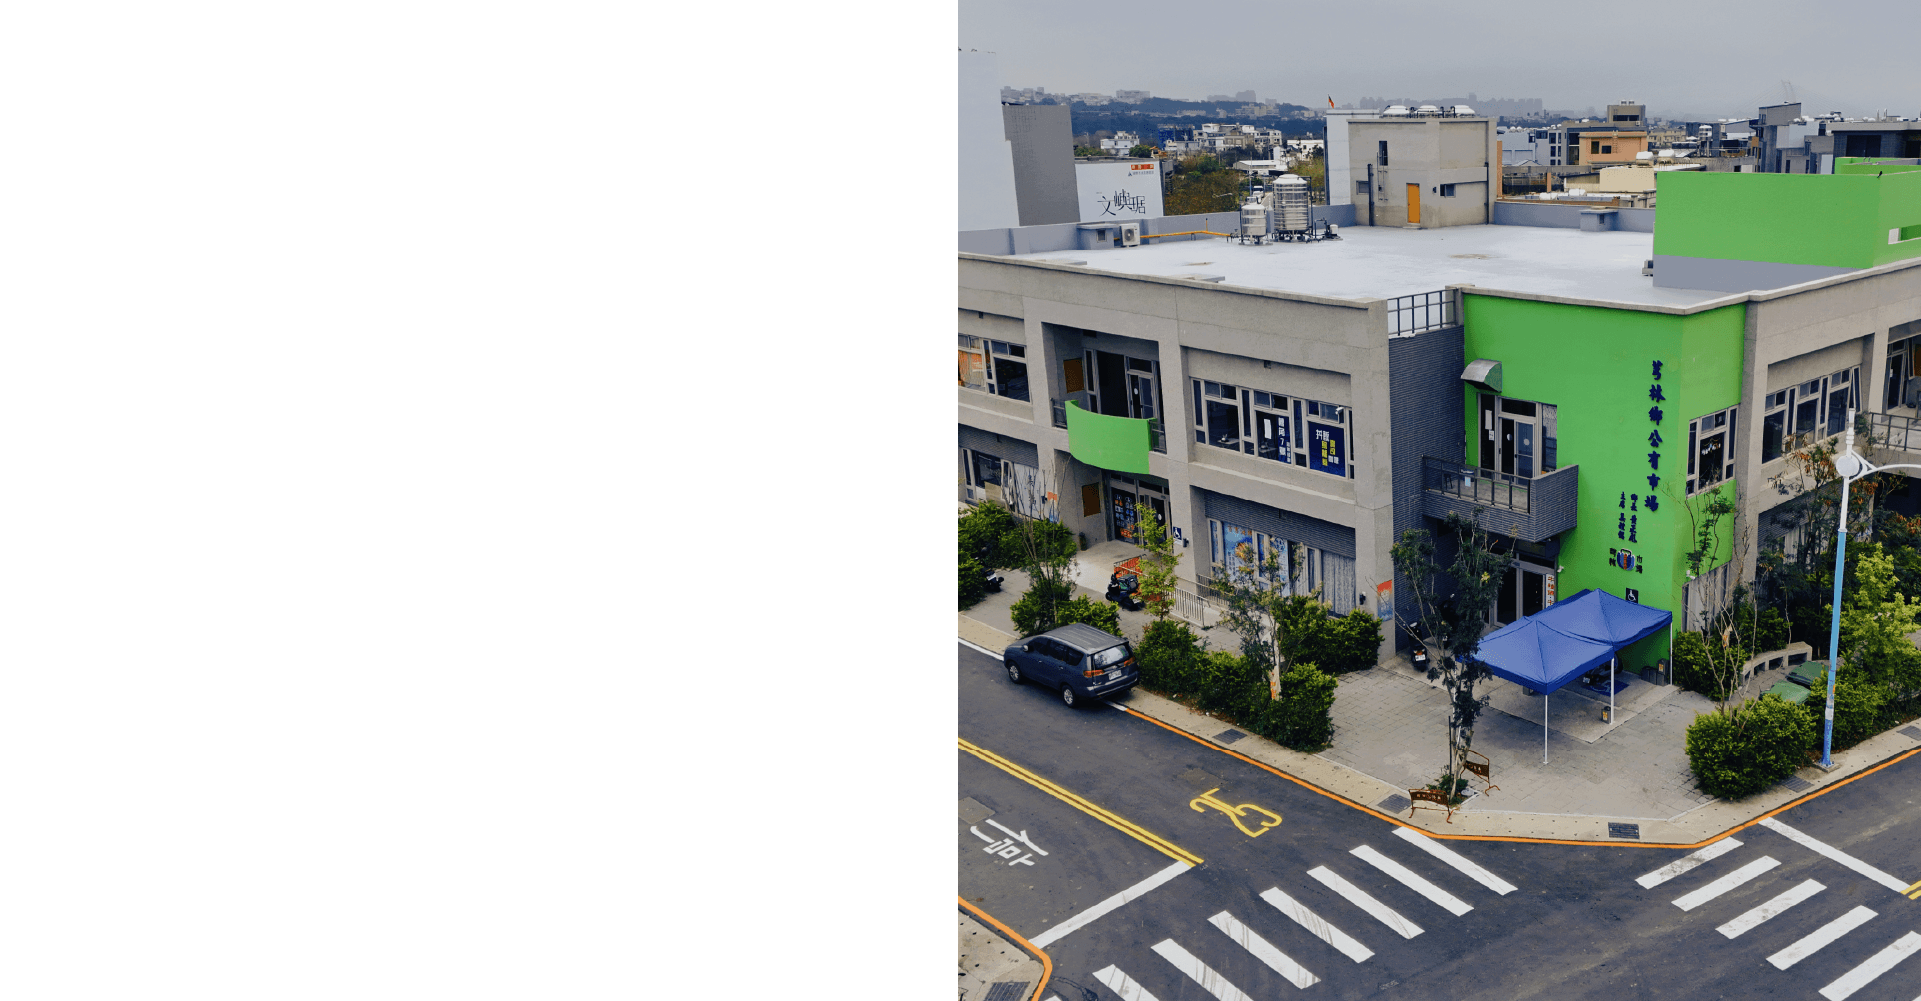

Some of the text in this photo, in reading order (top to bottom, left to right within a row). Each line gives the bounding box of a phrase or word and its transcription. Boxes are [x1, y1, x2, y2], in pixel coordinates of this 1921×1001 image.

[1644, 359, 1666, 512] 芎林鄉公有市場
[1188, 787, 1283, 839] 25
[969, 818, 1049, 866] 停
